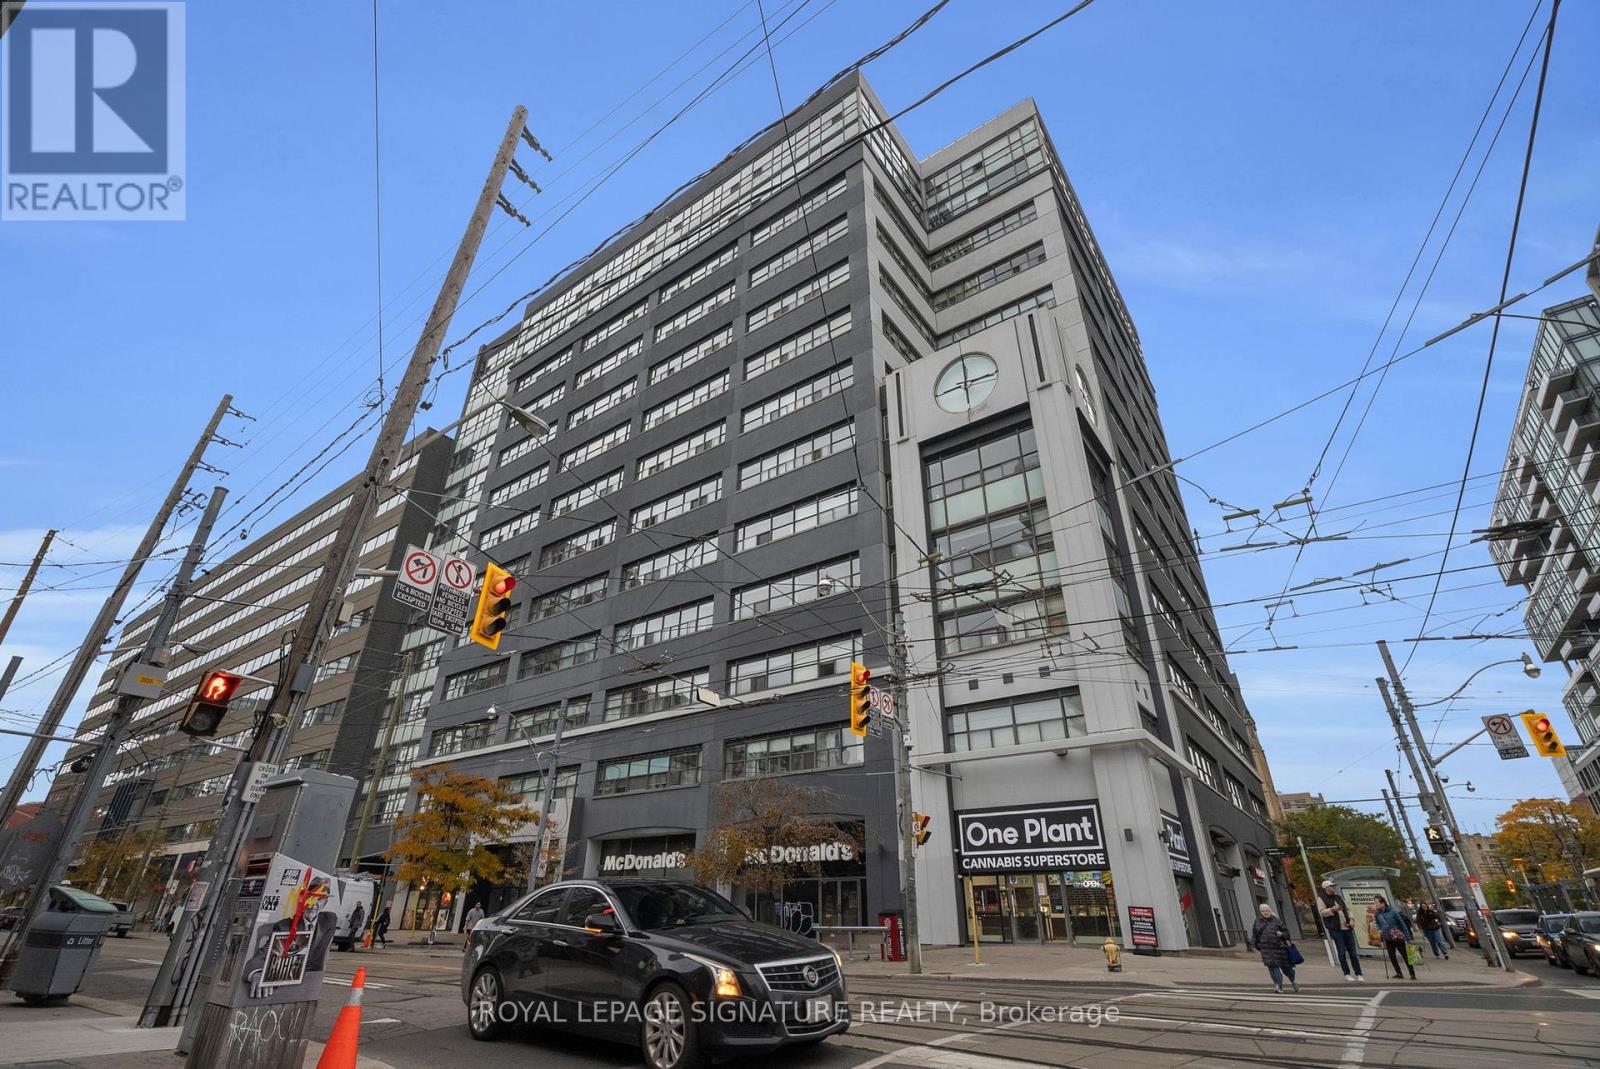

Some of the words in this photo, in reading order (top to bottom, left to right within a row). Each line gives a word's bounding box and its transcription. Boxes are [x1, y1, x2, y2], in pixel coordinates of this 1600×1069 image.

[396, 591, 426, 608] EXCEPTED
[397, 583, 406, 591] TTC
[409, 588, 431, 602] BICYCLES
[442, 592, 466, 604] VEHICLES
[436, 596, 446, 604] AND
[447, 600, 468, 611] BICYCLES
[437, 603, 464, 617] EXCEPTED
[967, 821, 1019, 846] One
[1024, 816, 1094, 843] Plant
[603, 850, 686, 871] McDonald's
[962, 856, 1022, 869] CANNABIS
[1023, 853, 1106, 867] SUPERSTORE
